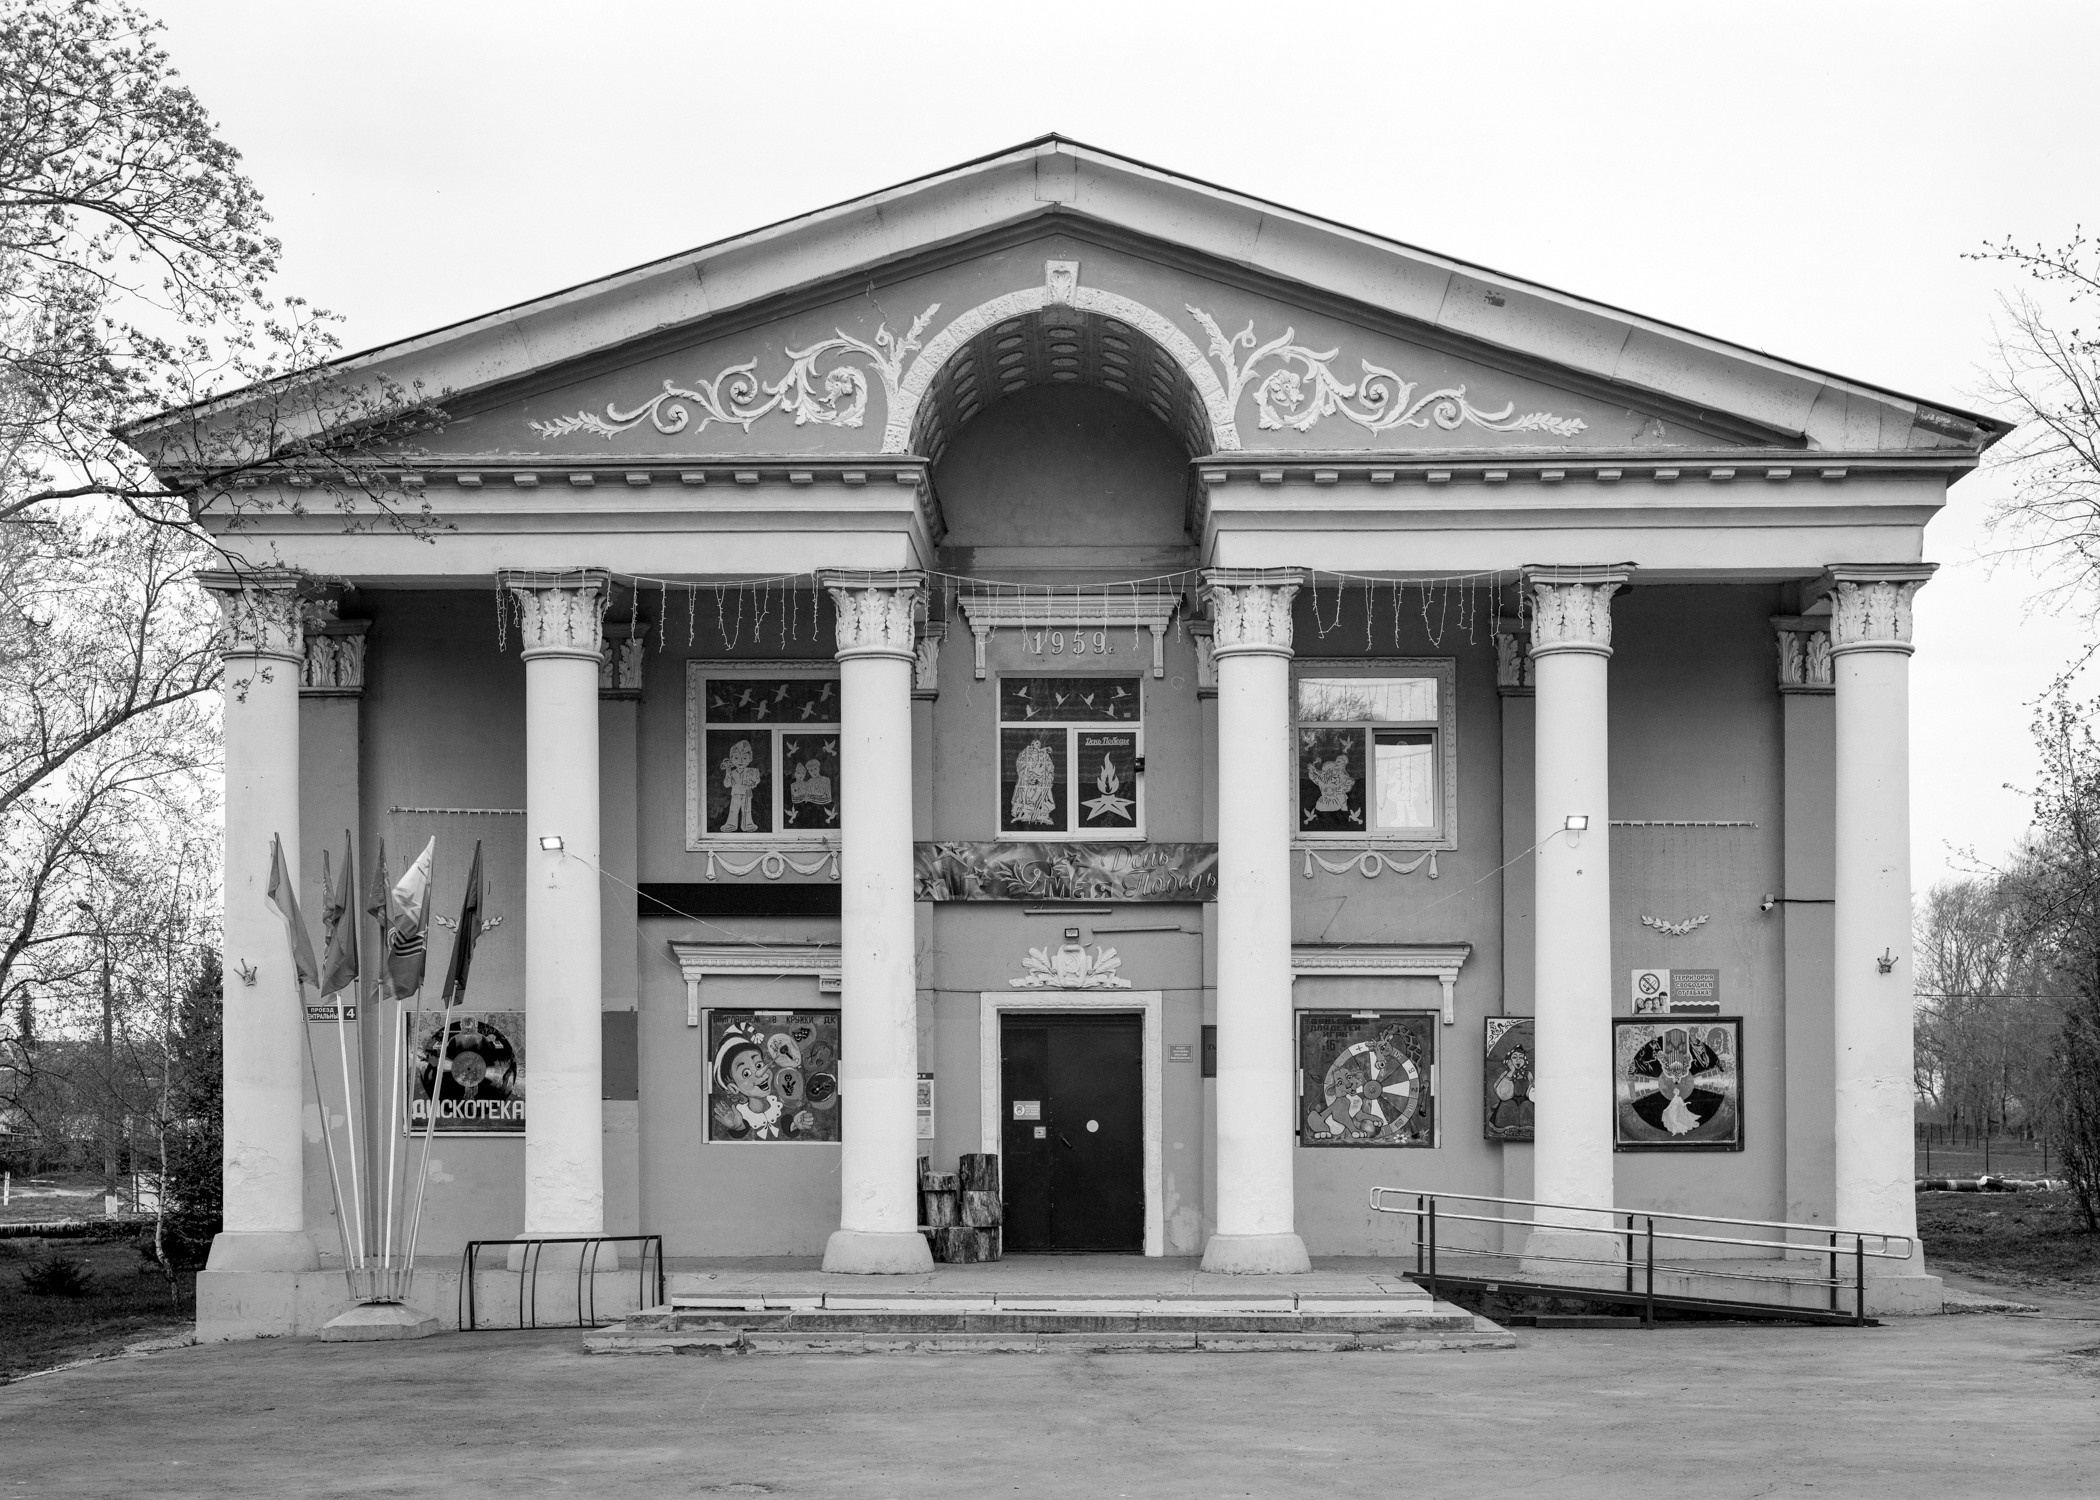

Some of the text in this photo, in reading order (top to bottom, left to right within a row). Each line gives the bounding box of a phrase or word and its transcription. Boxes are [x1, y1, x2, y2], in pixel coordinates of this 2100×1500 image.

[1101, 846, 1169, 873] День
[346, 1008, 355, 1019] 4
[823, 1016, 836, 1024] ДК
[412, 1099, 525, 1119] ДИСКОТЕКА
